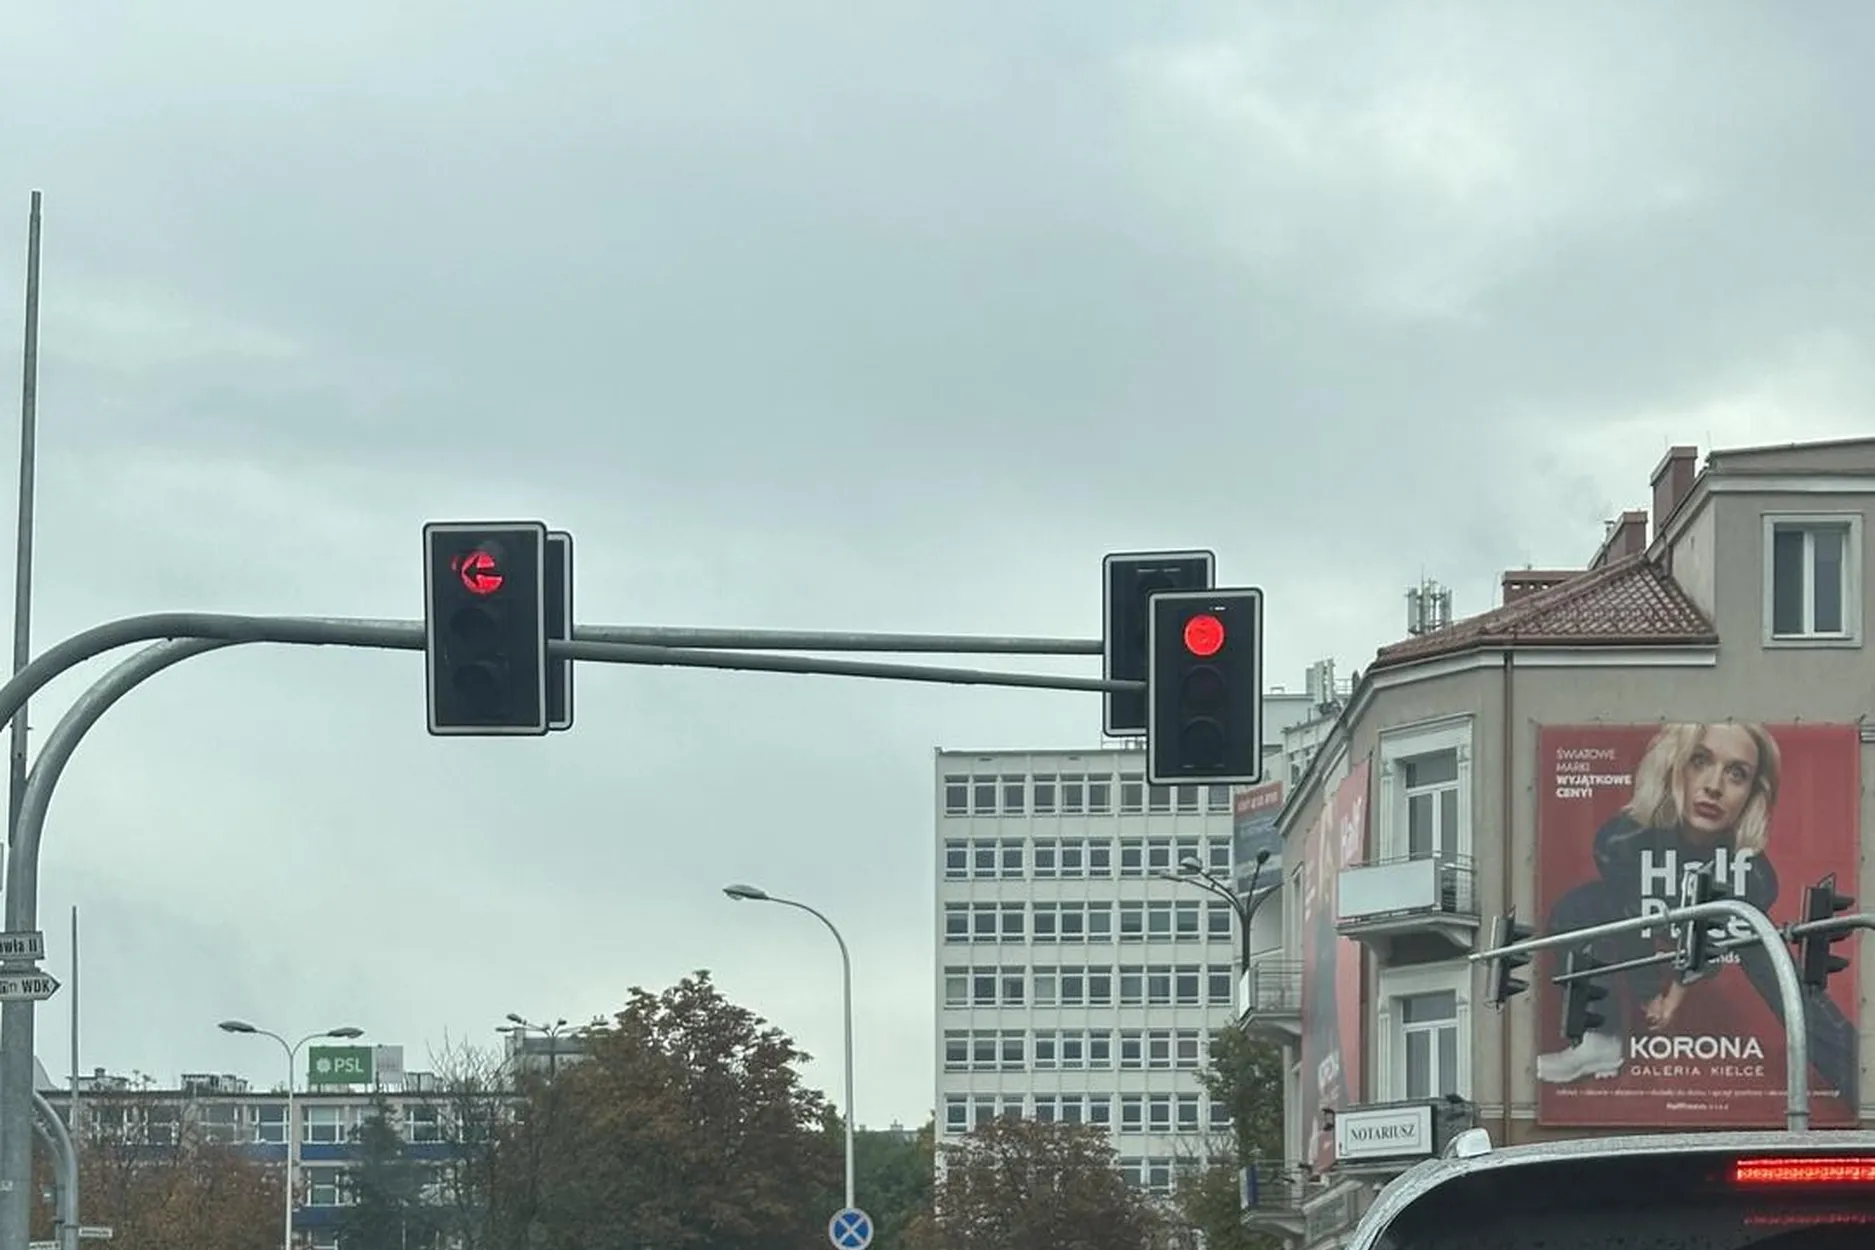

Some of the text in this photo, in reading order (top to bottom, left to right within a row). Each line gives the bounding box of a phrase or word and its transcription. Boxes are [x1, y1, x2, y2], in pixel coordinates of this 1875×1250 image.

[1556, 775, 1632, 787] WYJĄTKOWE
[22, 979, 50, 994] WDK
[1630, 1035, 1764, 1060] KORONA
[334, 1057, 364, 1073] PSL
[1630, 1065, 1765, 1077] GALERIA KIELCE
[1350, 1123, 1415, 1141] NOTARIUSZ
